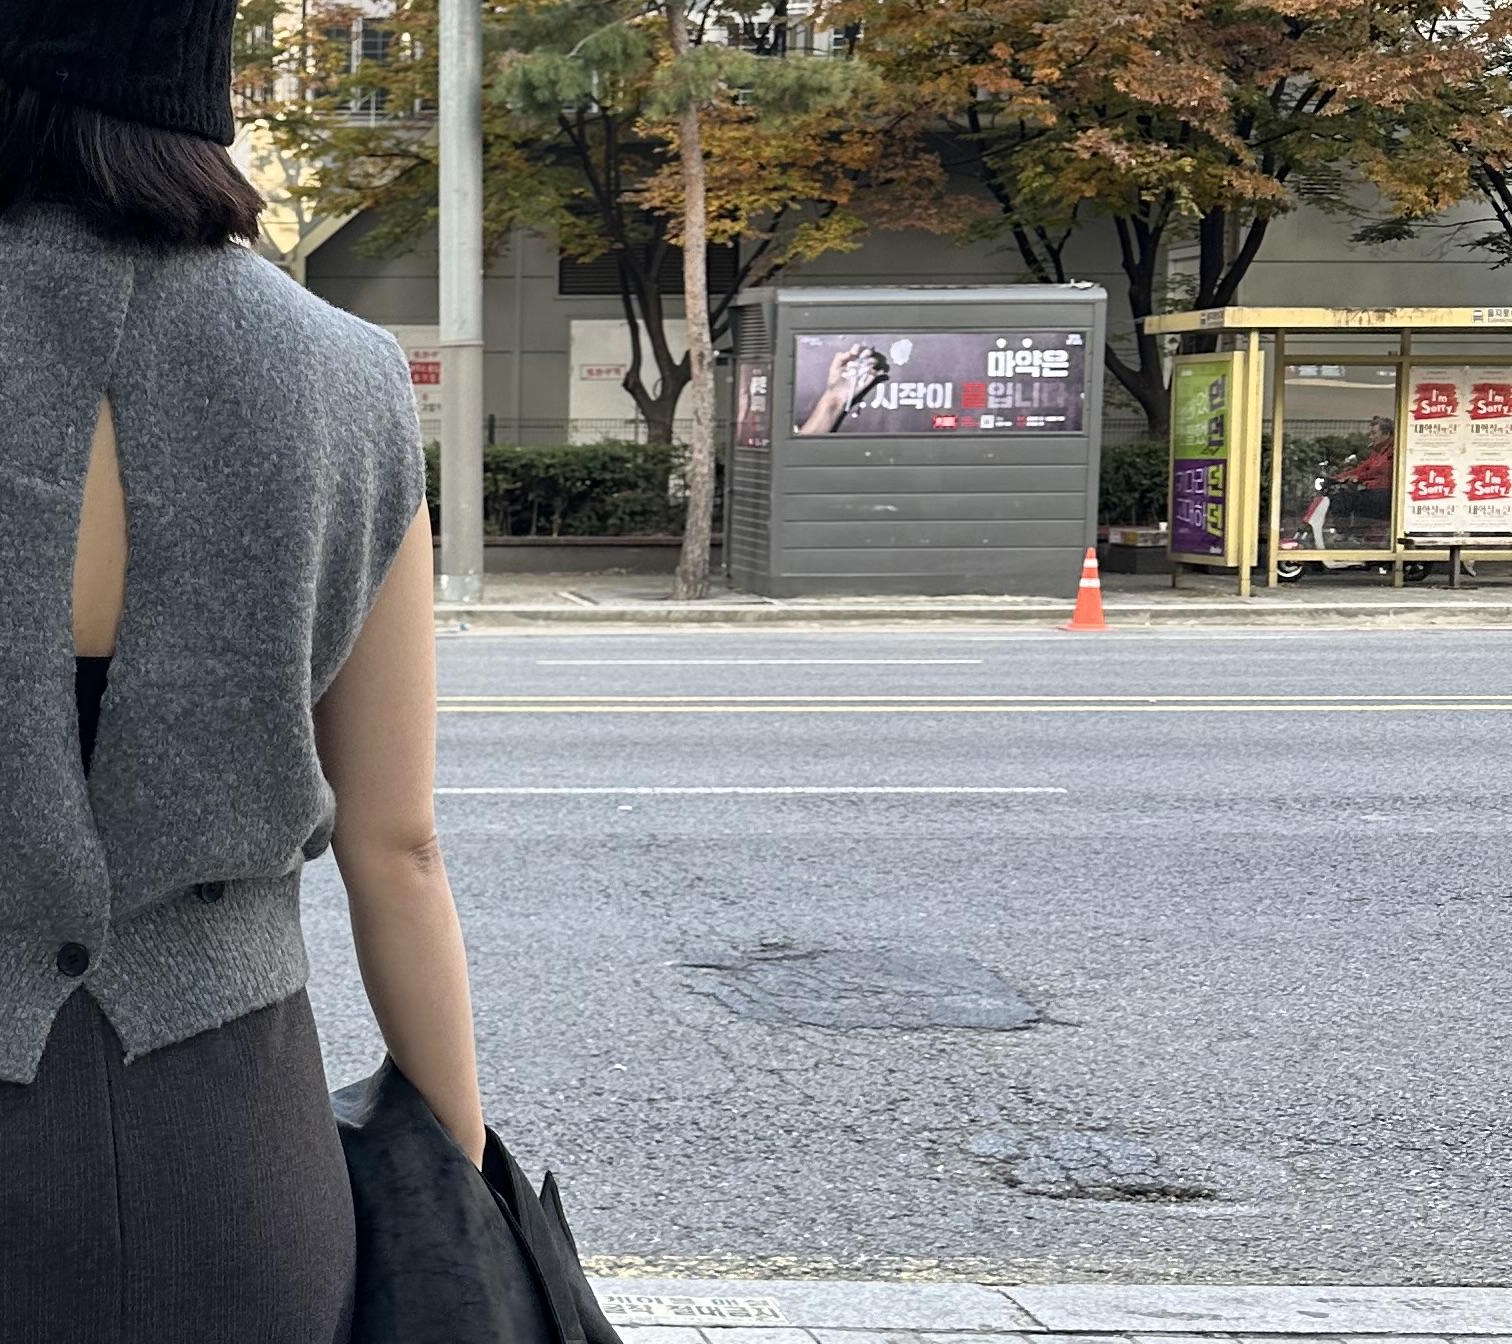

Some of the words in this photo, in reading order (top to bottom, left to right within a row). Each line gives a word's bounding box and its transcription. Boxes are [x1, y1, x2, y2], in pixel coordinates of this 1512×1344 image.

[988, 349, 1070, 378] 마약은
[871, 382, 953, 409] 시작이
[1421, 399, 1453, 416] Sorry
[1477, 399, 1509, 415] Sorry
[1418, 481, 1450, 496] Sorry
[1474, 481, 1506, 496] Sorry
